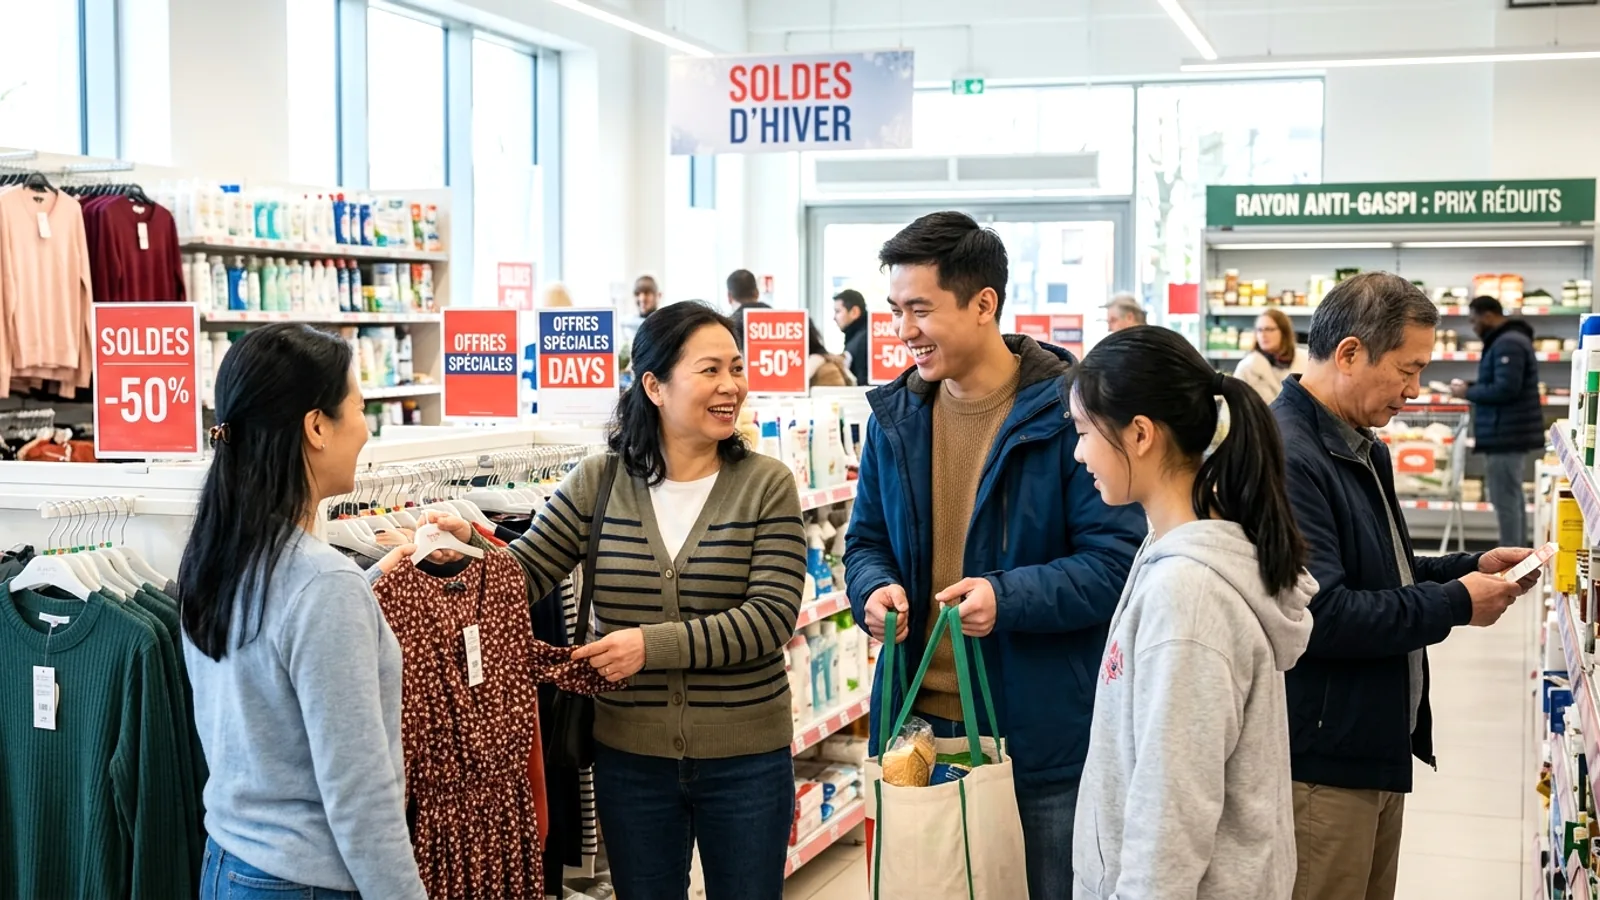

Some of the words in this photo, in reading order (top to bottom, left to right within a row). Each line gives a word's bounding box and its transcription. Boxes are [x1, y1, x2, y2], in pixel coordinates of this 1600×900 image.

[729, 61, 852, 103] SOLDES
[730, 105, 851, 144] D'HIVER
[1235, 191, 1300, 217] RAYON
[1303, 190, 1417, 216] ANTI-GASPI
[1421, 196, 1429, 214] :
[1434, 189, 1477, 214] PRIX
[1482, 184, 1562, 214] RÉDUITS
[553, 315, 599, 332] OFFRES
[749, 322, 803, 340] SOLDES
[101, 327, 190, 356] SOLDES
[454, 333, 507, 352] OFFRES
[544, 332, 610, 351] SPÉCIALES
[448, 353, 513, 372] SPÉCIALES
[750, 349, 803, 377] -50%
[874, 344, 912, 368] -50
[548, 356, 606, 385] DAYS
[104, 376, 189, 423] -50%
